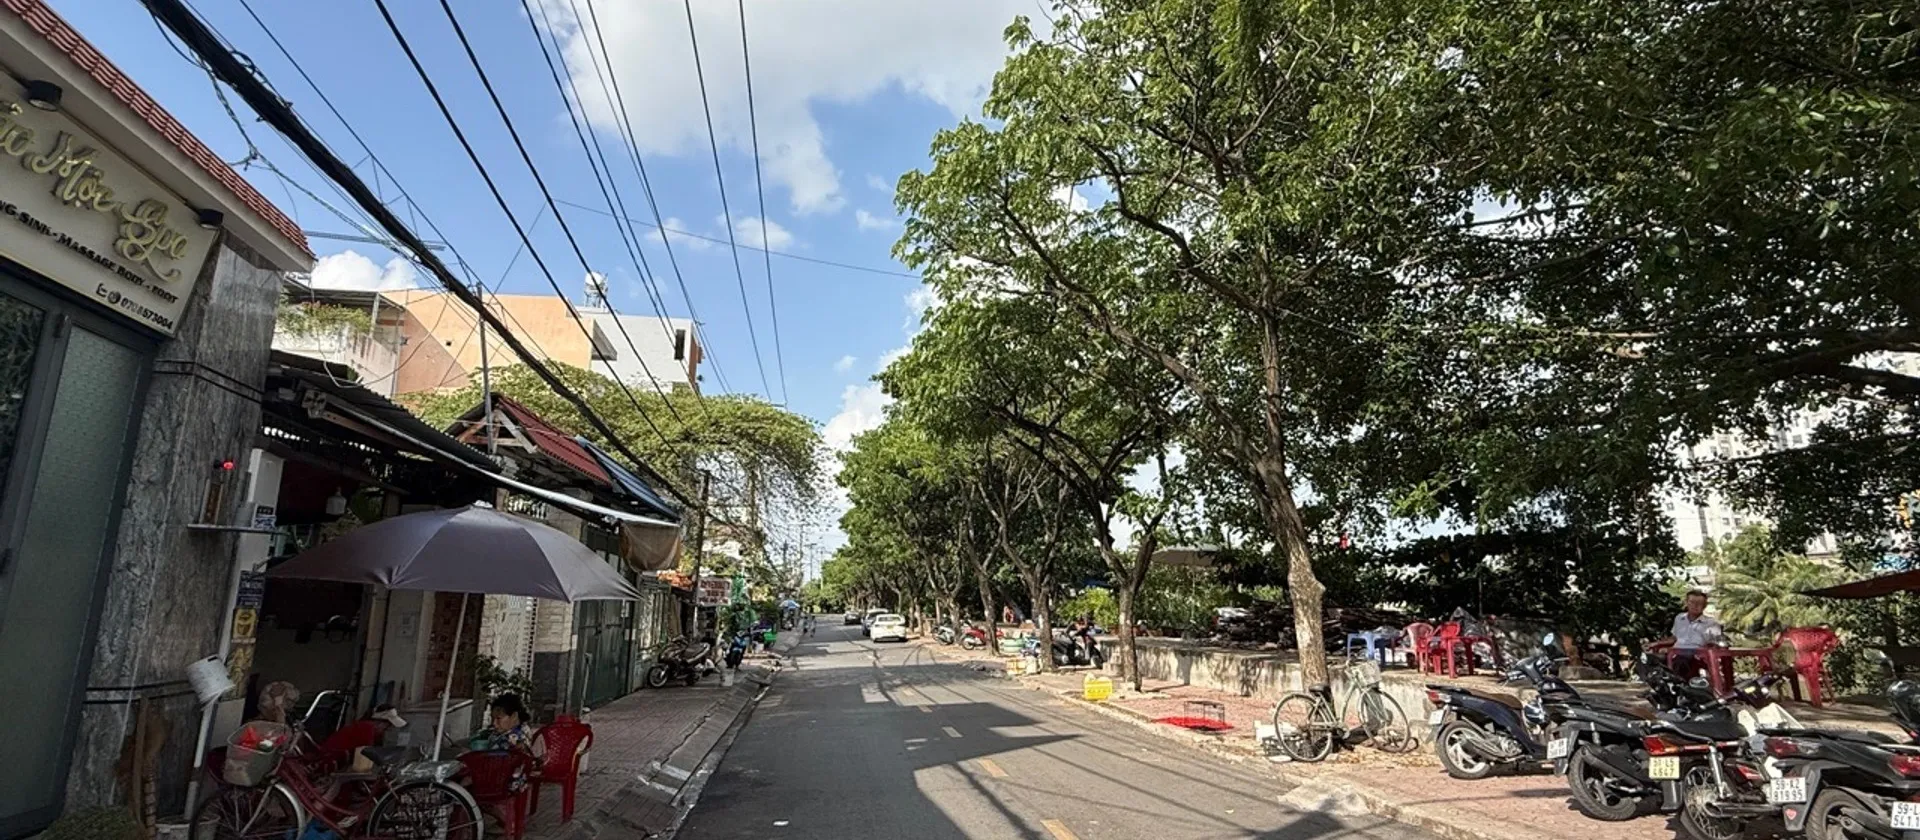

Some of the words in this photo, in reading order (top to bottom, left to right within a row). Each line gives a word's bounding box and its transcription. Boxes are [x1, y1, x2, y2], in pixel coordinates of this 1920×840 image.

[24, 131, 117, 212] Mộc
[116, 199, 188, 283] Spa
[56, 231, 117, 272] MASSAGE
[117, 264, 146, 287] BODY
[150, 285, 179, 304] FOOT
[1897, 803, 1920, 815] 59-L
